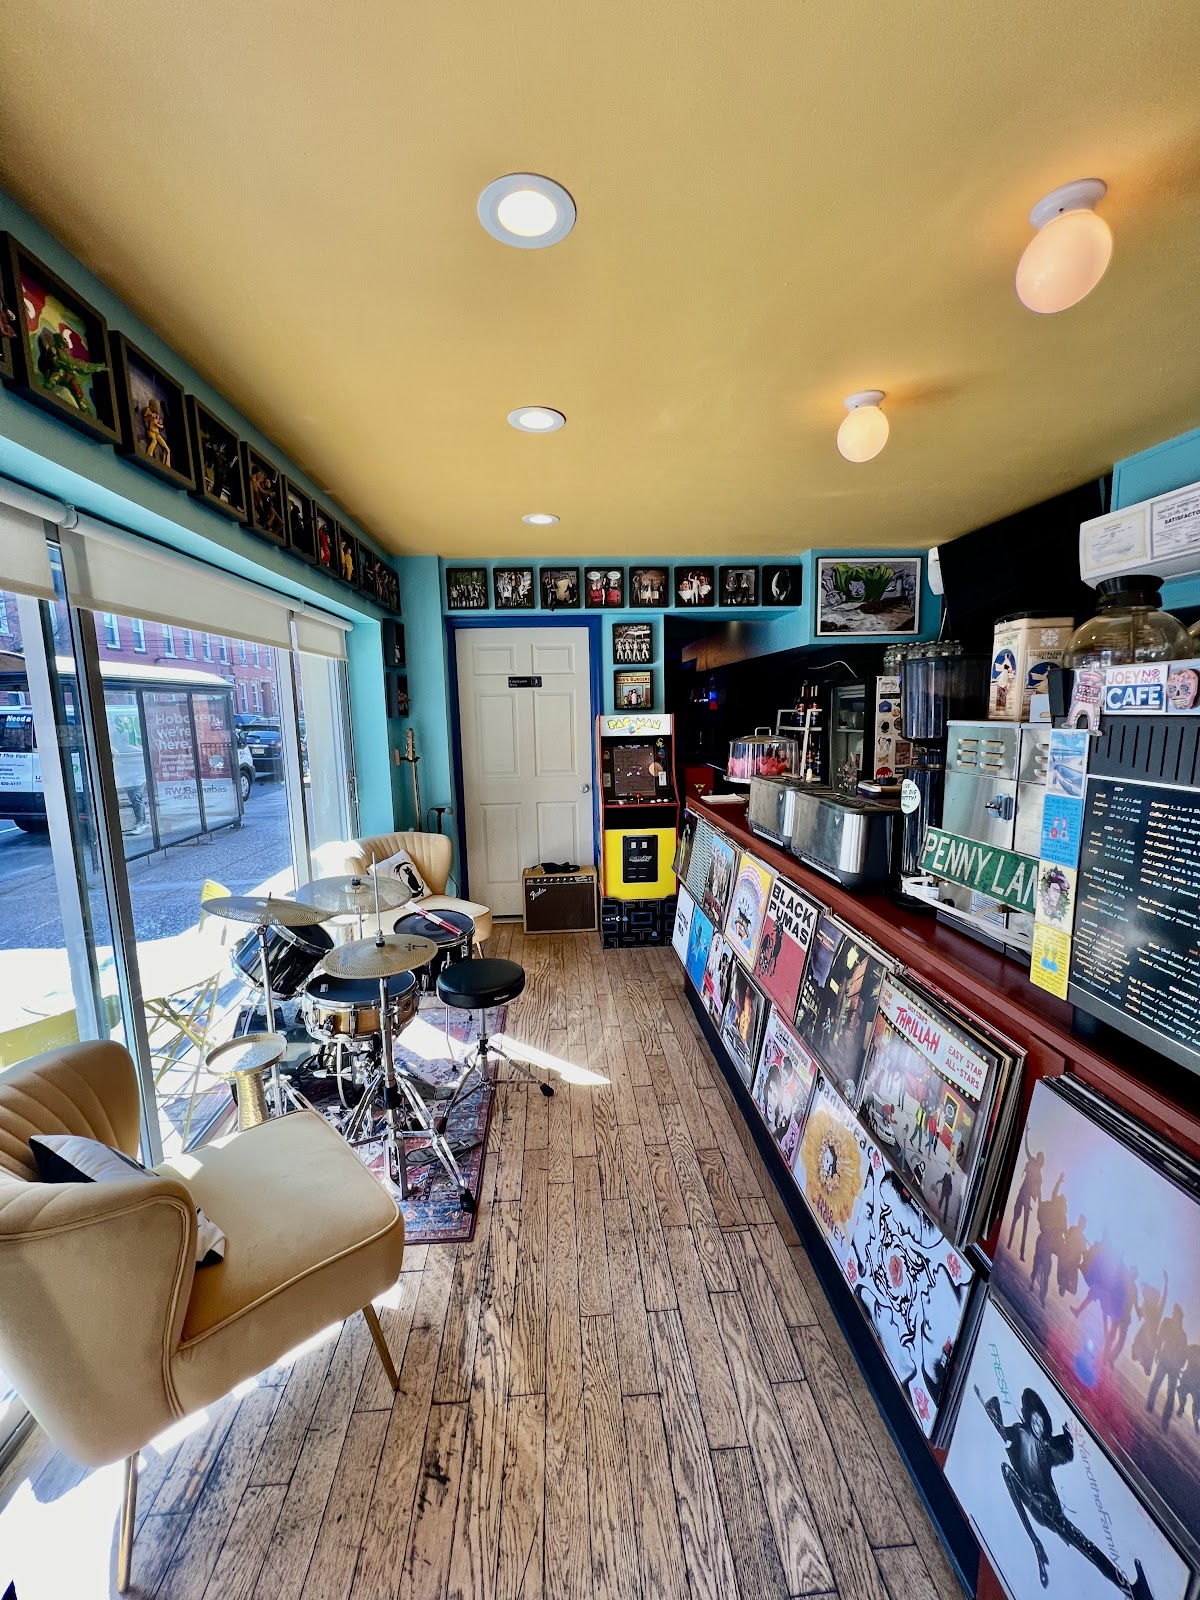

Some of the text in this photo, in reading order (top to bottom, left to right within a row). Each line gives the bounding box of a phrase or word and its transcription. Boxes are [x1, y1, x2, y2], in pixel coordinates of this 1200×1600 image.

[1164, 509, 1200, 525] SATISFACTO
[1108, 671, 1141, 684] JOEY
[1107, 687, 1160, 709] CAFE
[160, 740, 192, 751] here.
[165, 785, 228, 796] RWJBanabas
[921, 832, 1038, 908] PENNY LAN
[772, 883, 813, 929] BLACK
[769, 901, 809, 946] PUMAS
[895, 1006, 941, 1055] THRILLAH
[945, 1058, 980, 1089] ALL-STARS
[948, 1045, 983, 1078] EASY STAR
[989, 1343, 1011, 1405] FRESH
